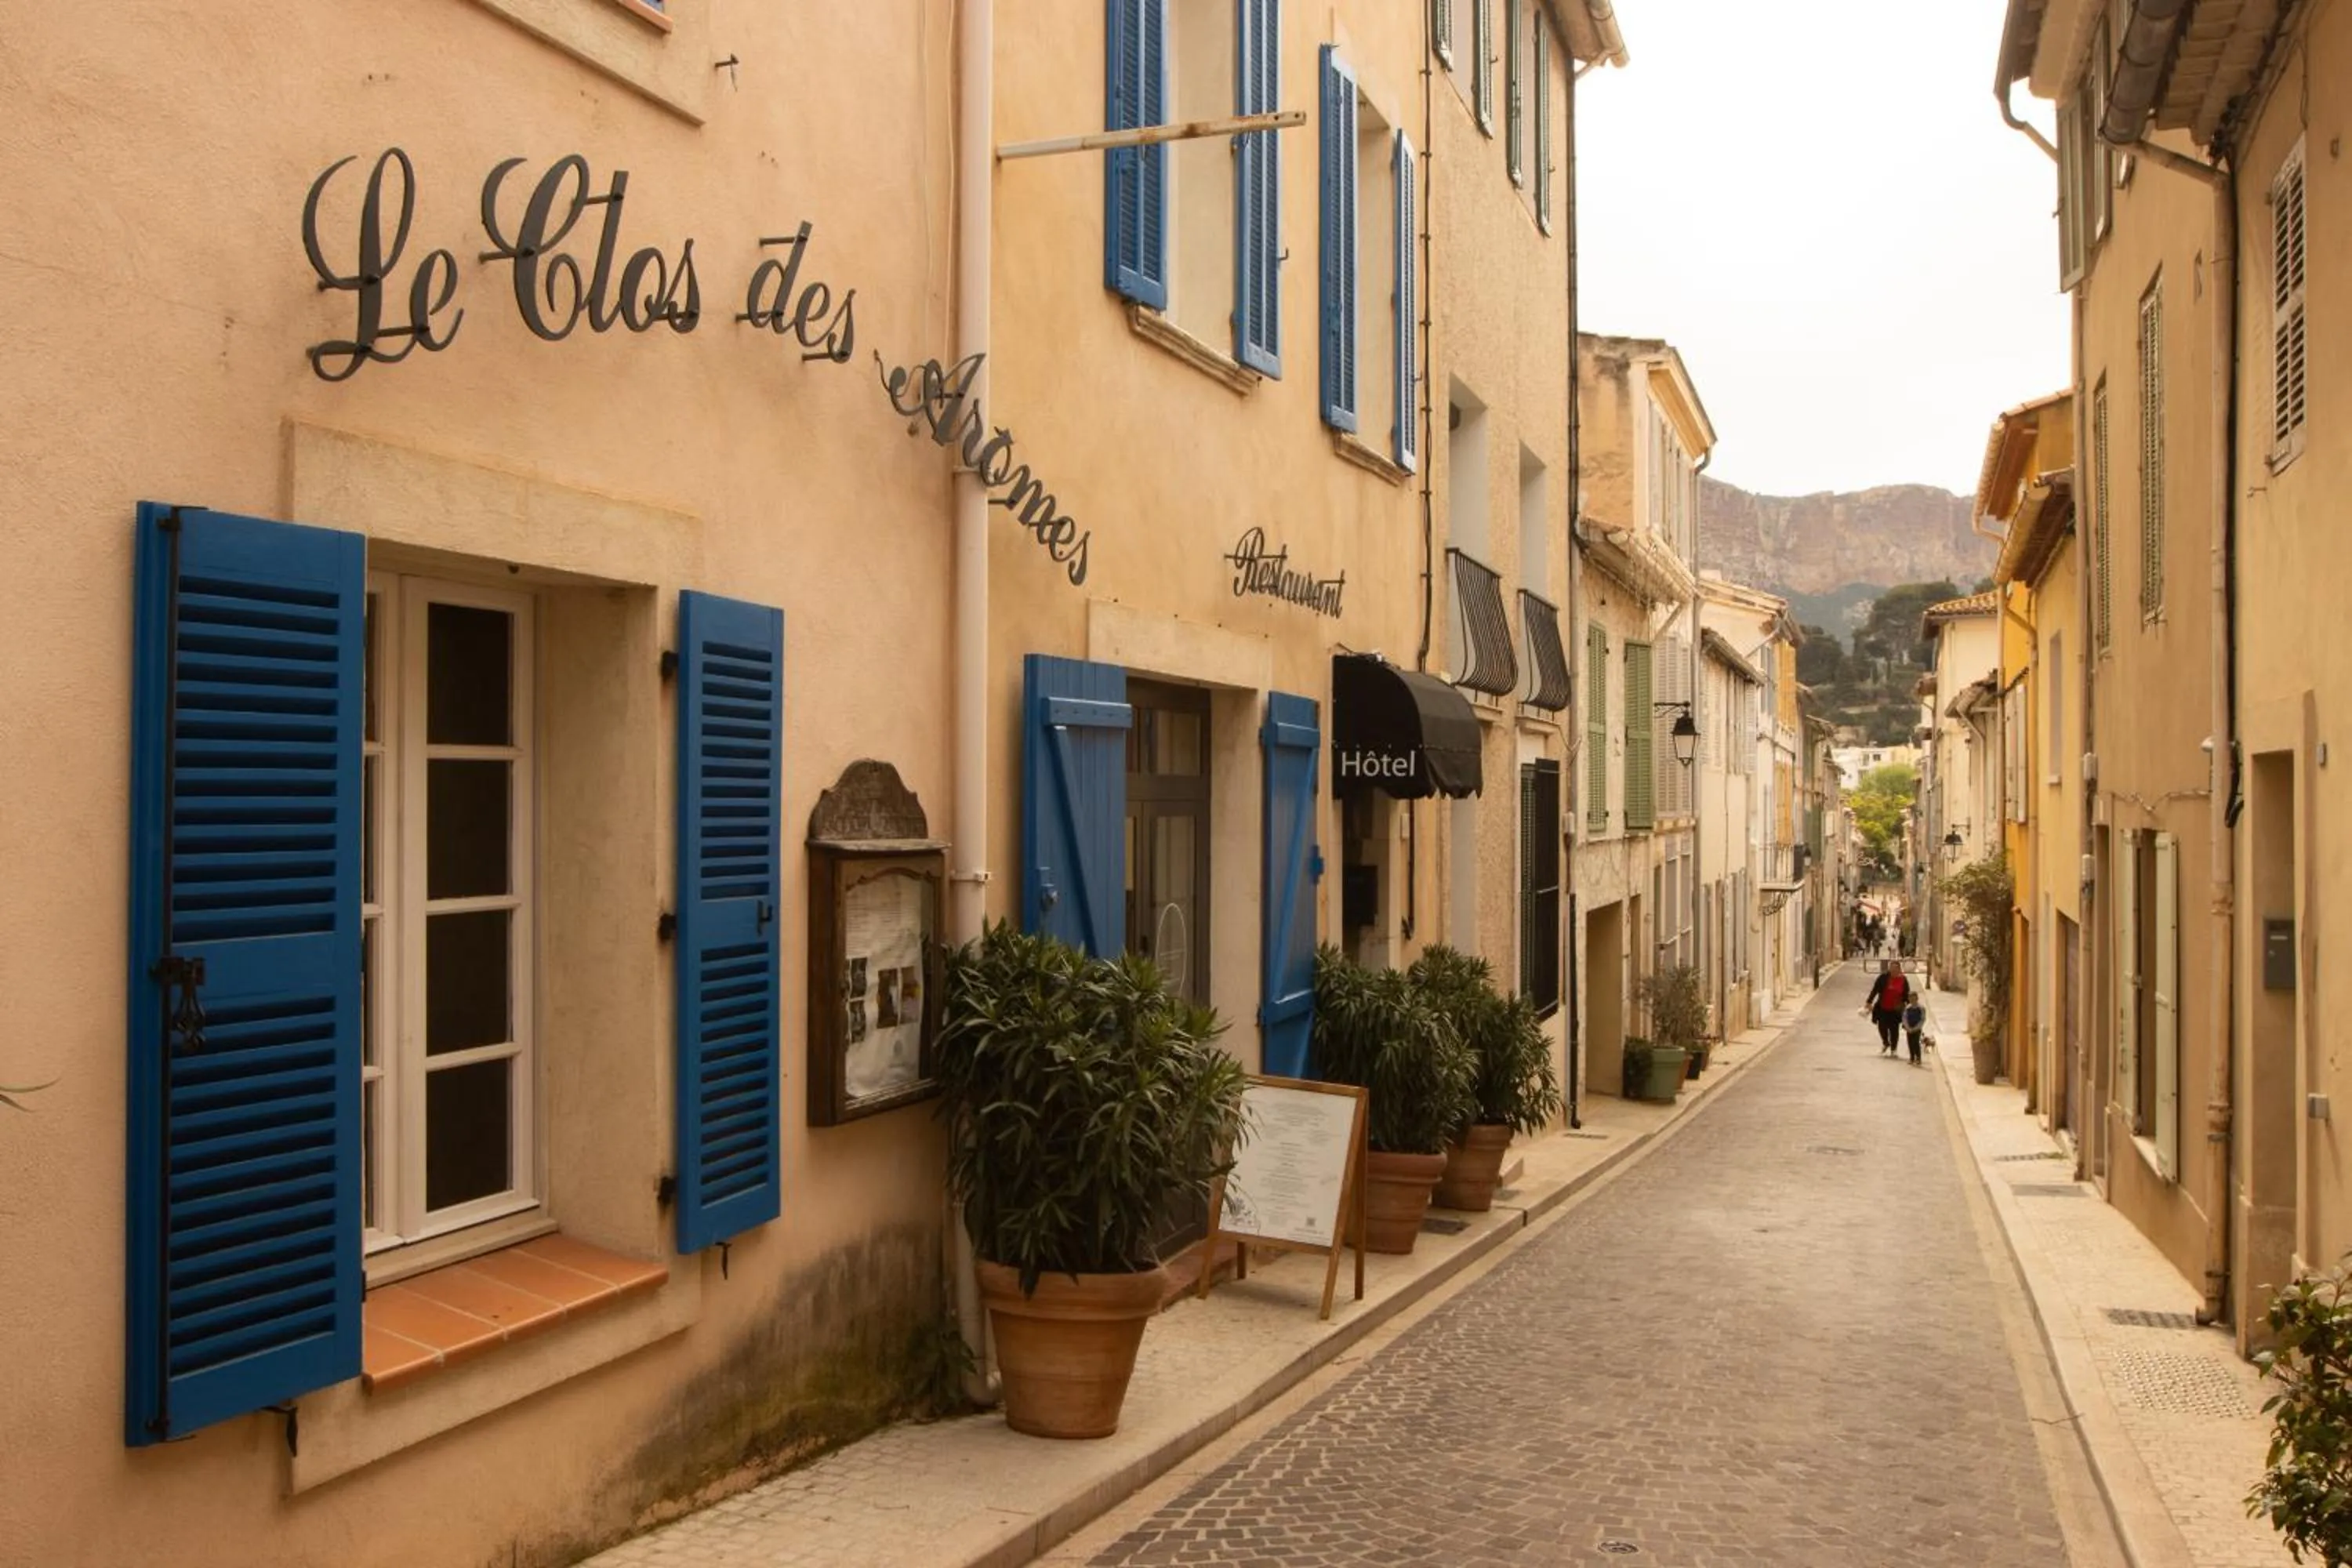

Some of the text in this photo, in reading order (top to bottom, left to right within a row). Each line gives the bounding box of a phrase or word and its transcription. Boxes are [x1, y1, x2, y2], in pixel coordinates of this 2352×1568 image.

[303, 147, 463, 381] Le
[481, 154, 701, 340] Clos
[747, 221, 856, 363] des
[1232, 526, 1345, 619] Restaurant
[1341, 750, 1416, 777] Hôtel
